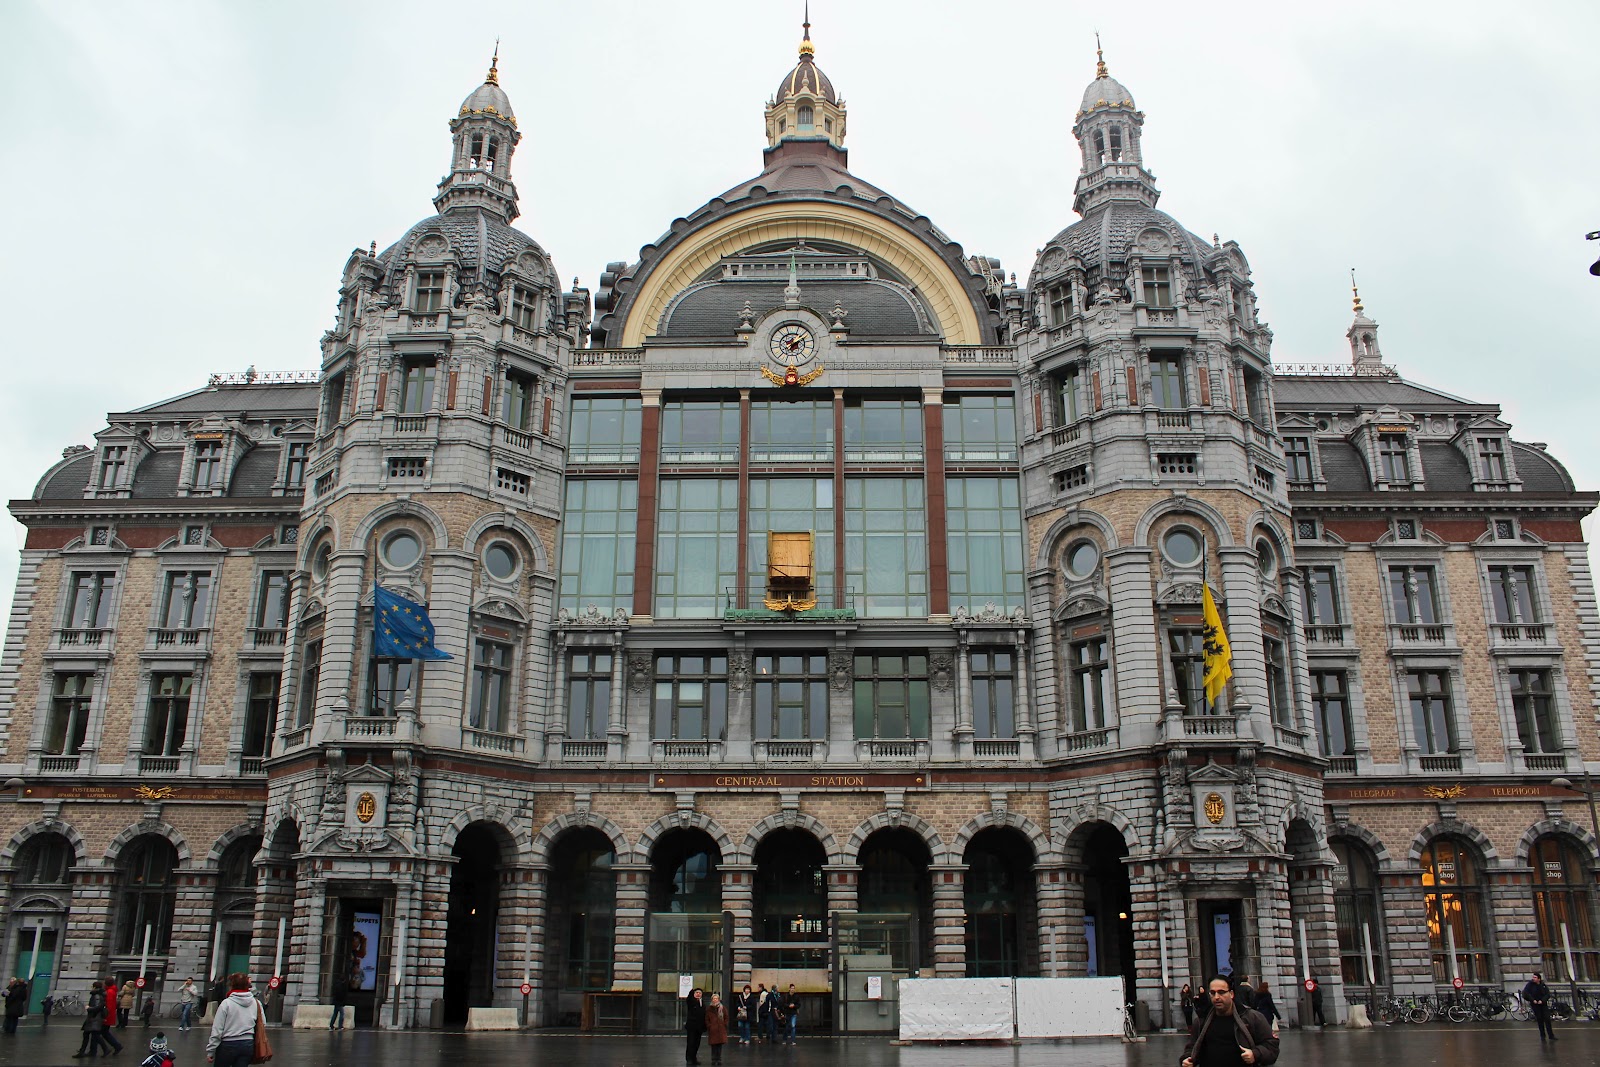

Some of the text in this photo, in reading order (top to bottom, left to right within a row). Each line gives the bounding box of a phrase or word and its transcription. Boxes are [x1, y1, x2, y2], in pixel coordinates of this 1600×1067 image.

[716, 776, 864, 786] CENTRAAL STATION
[1349, 789, 1396, 798] TELEGRAAF
[1491, 787, 1540, 796] TELEPHOON
[1333, 874, 1348, 882] shop
[1440, 871, 1455, 880] shop
[1546, 871, 1562, 879] shop
